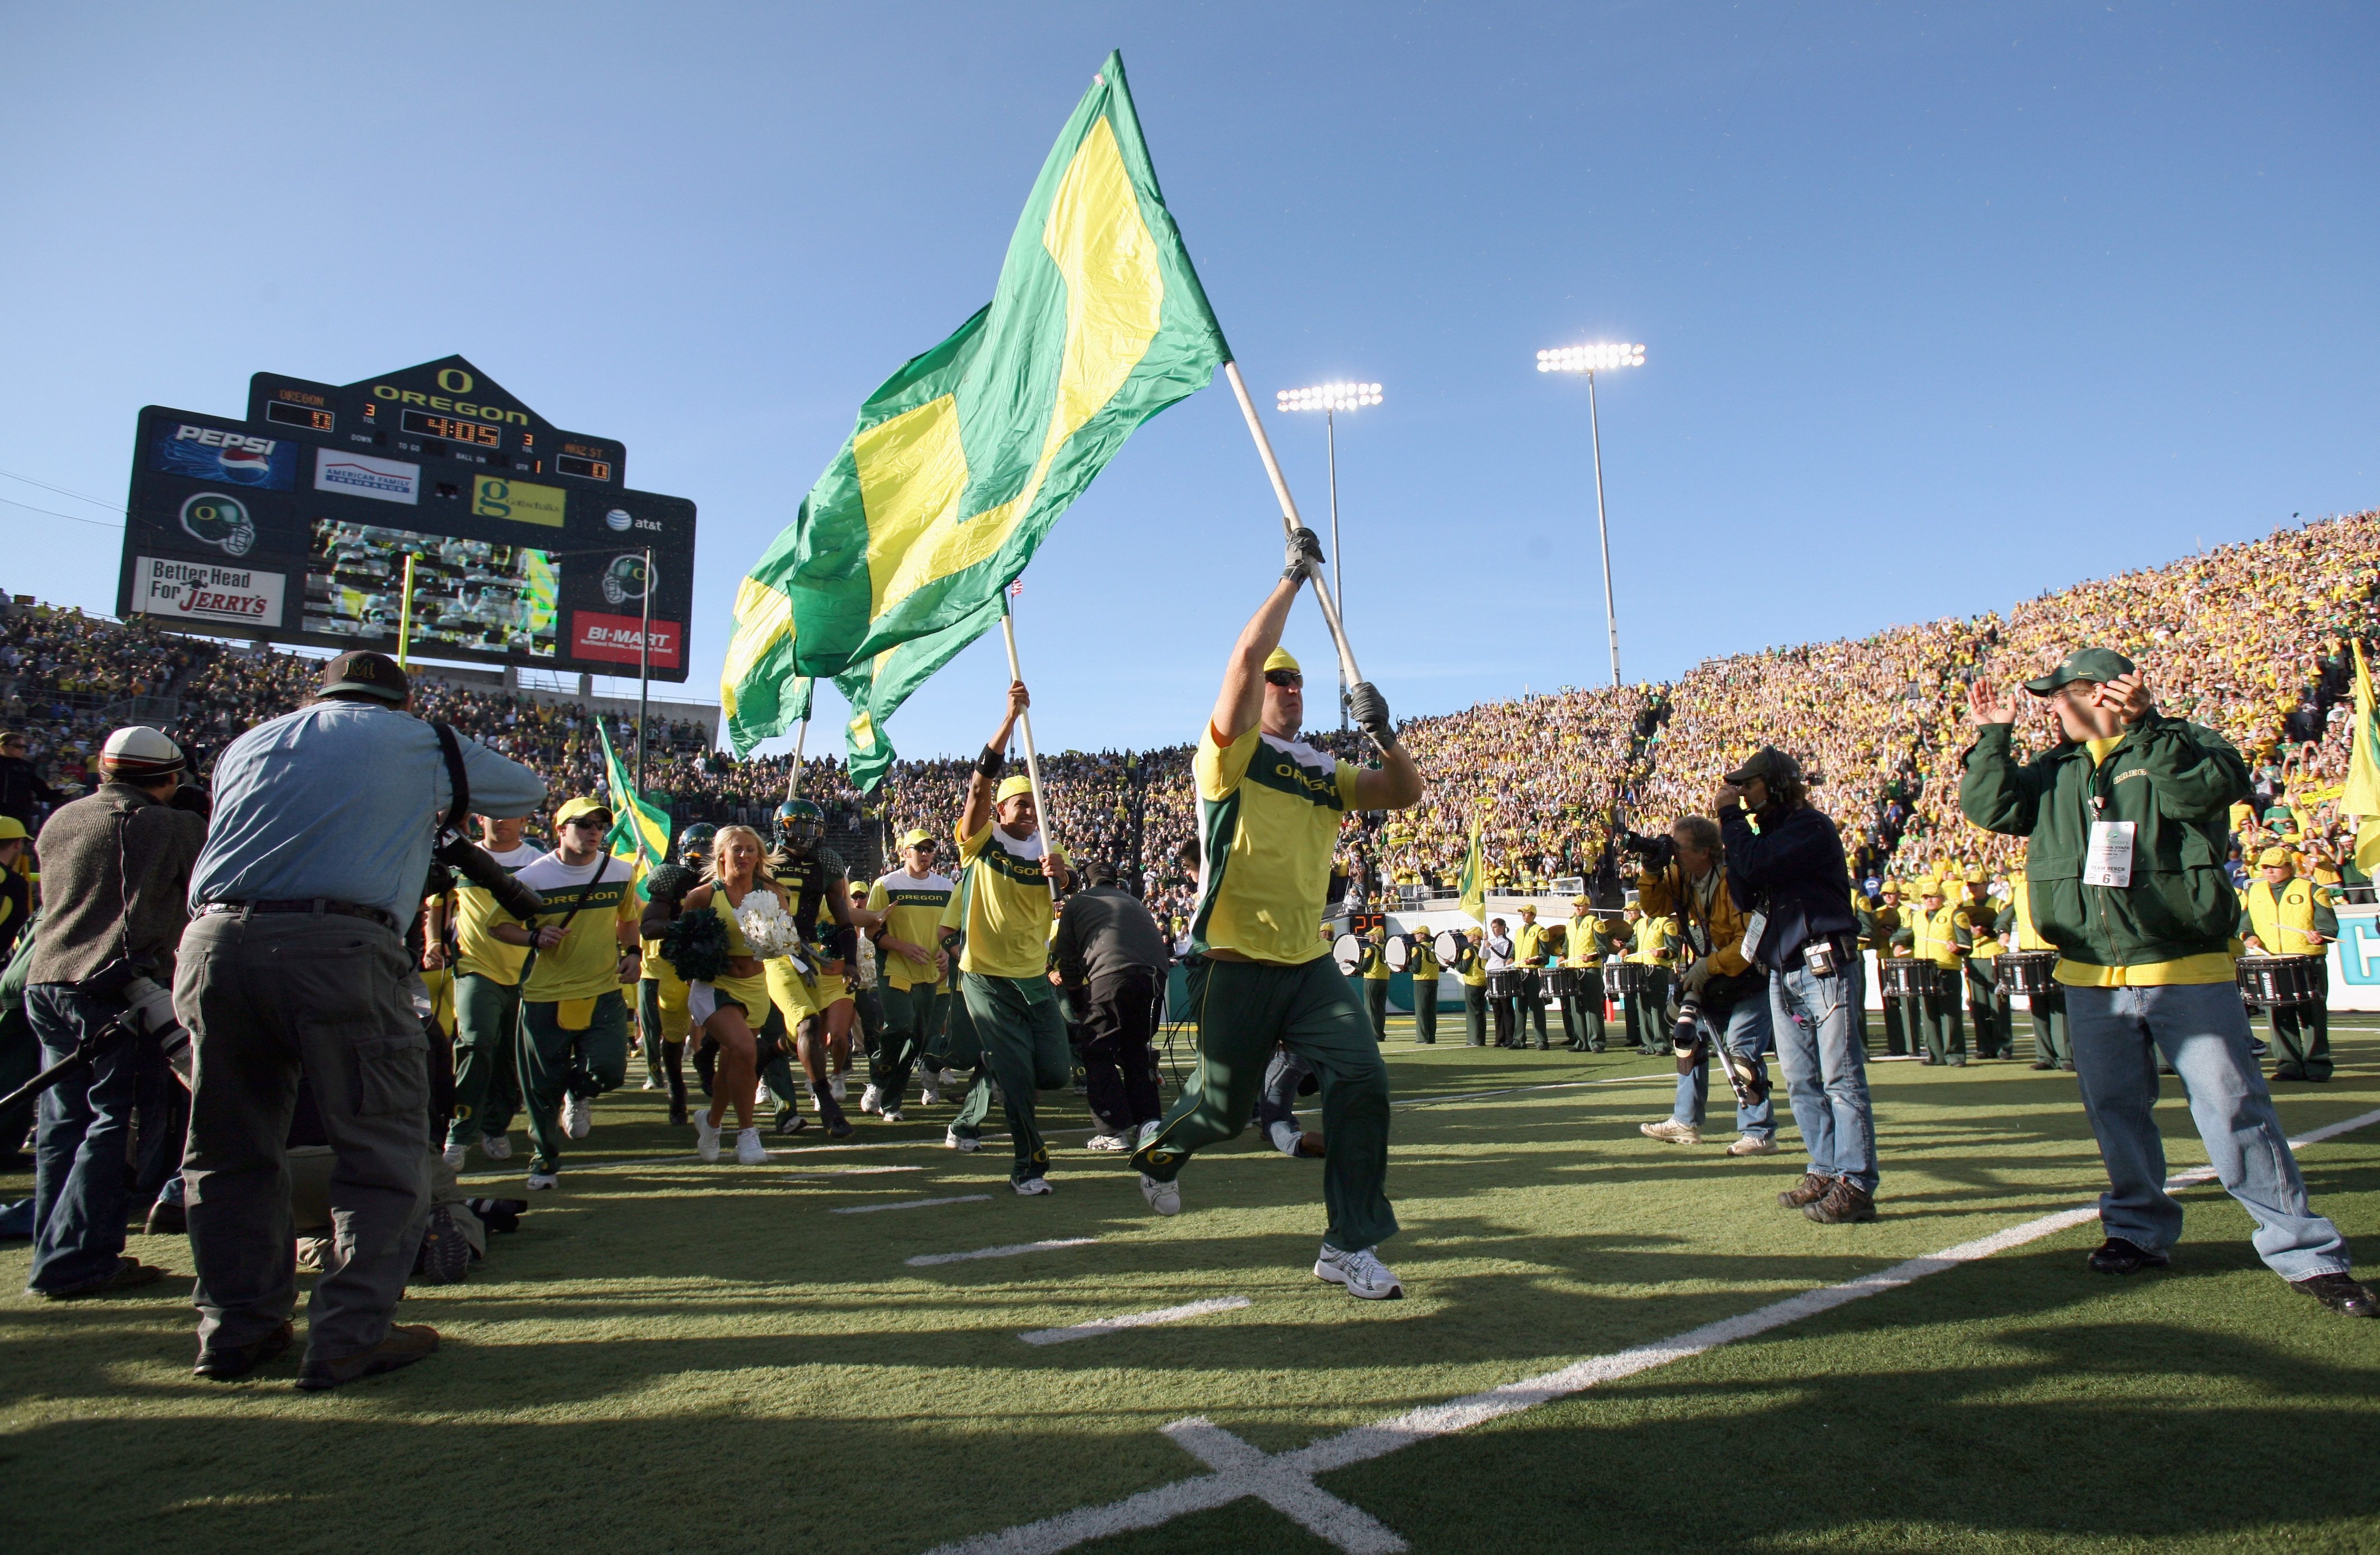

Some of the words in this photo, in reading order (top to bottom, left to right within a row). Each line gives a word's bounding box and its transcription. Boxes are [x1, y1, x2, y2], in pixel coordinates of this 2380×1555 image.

[438, 368, 473, 393] O
[278, 390, 324, 406] OREGON
[373, 386, 528, 426] OREGON
[365, 403, 376, 416] 3
[175, 425, 277, 456] PEPSI
[351, 434, 372, 443] DOWN
[427, 419, 498, 447] 4:05
[522, 434, 533, 445] 3
[455, 453, 473, 462] BALL
[589, 448, 603, 458] ST
[327, 468, 374, 481] AMERICAN
[378, 477, 411, 486] FAMILY
[332, 477, 404, 492] INSURANCE
[635, 518, 662, 531] at&t
[153, 561, 207, 581] Better
[211, 568, 251, 588] Head
[151, 581, 181, 599] For
[179, 588, 267, 614] JERRY'S
[342, 658, 375, 679] M
[2103, 874, 2111, 884] 6
[2263, 977, 2275, 1000] YAMAHA
